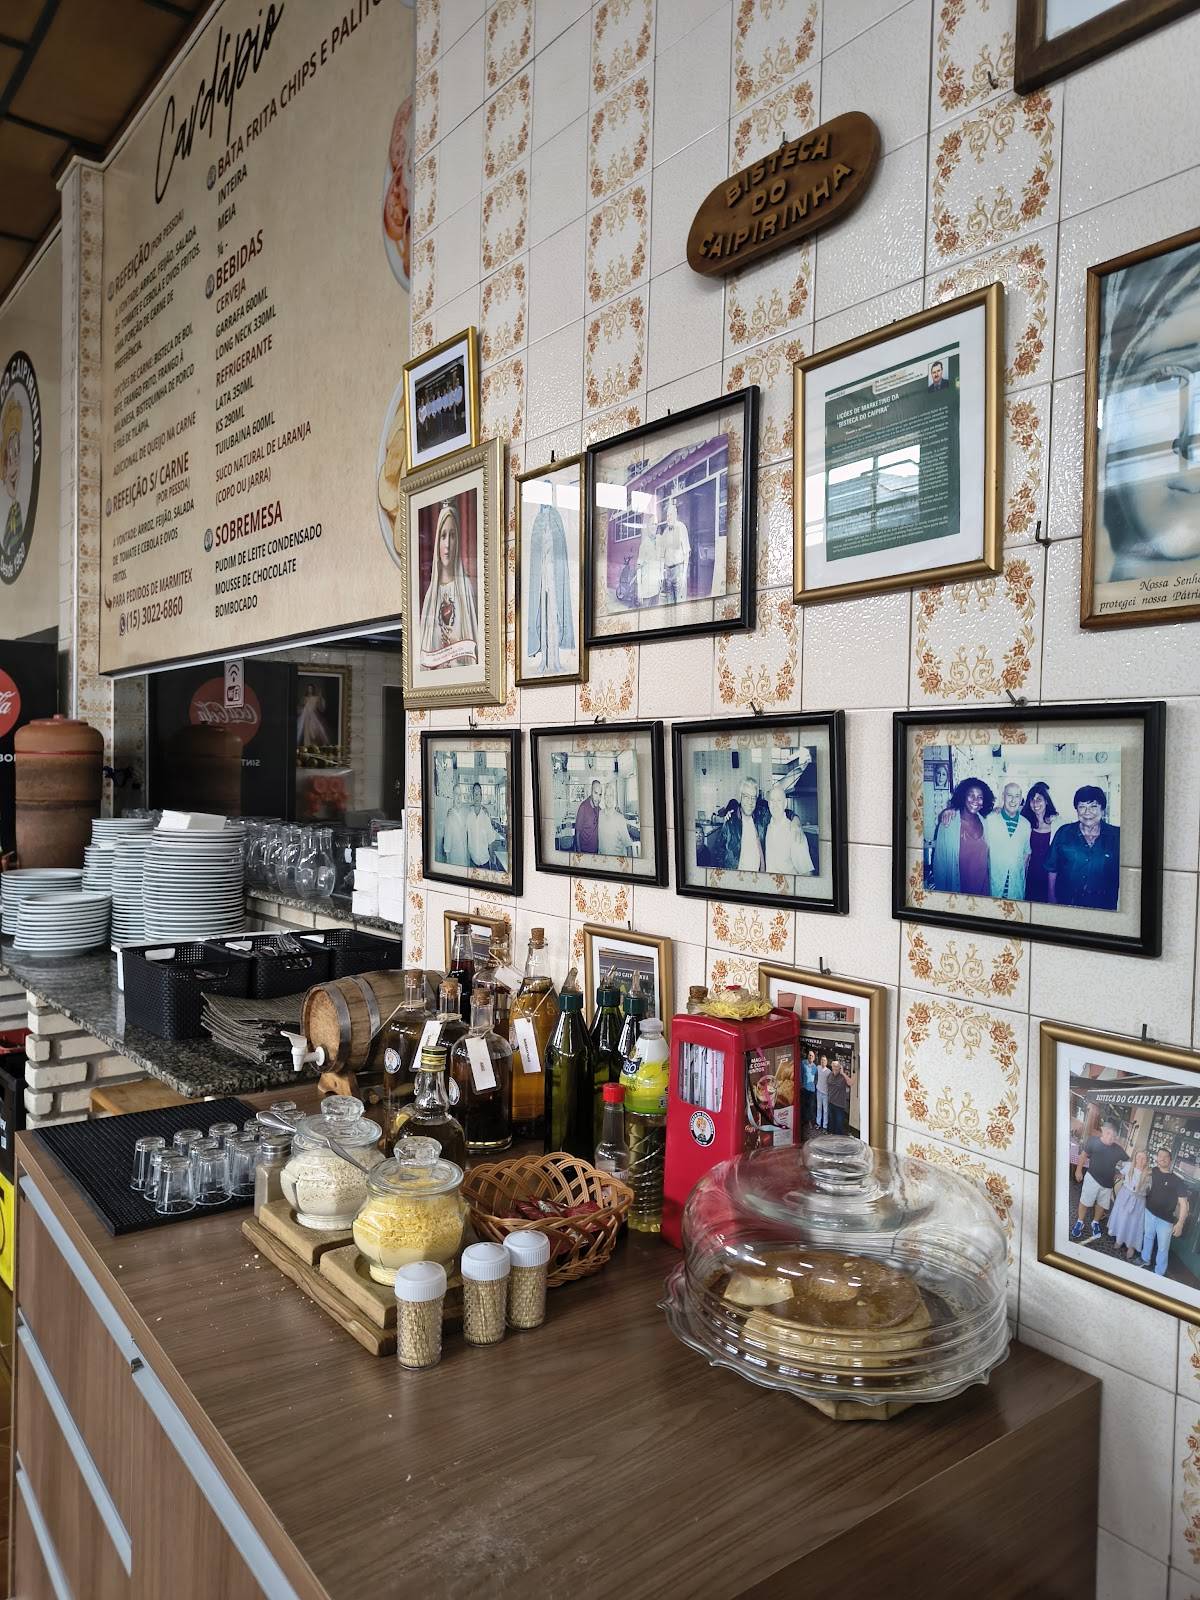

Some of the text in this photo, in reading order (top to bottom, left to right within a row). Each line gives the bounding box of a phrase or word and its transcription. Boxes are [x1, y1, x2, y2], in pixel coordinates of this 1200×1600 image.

[155, 3, 284, 205] Cardápio
[218, 136, 244, 178] BATA
[246, 98, 278, 147] FRITA
[280, 52, 317, 109] CHIPS
[320, 39, 327, 66] E
[218, 164, 247, 206] INTEIRA
[726, 132, 832, 208] BISTECA
[218, 202, 236, 232] MEIA
[700, 162, 852, 259] CAIPIRINHA
[752, 179, 787, 215] DO
[175, 224, 197, 256] SALADA
[216, 229, 263, 290] BEBIDAS
[115, 242, 150, 294] REFEIÇÃO
[143, 282, 161, 308] CEBOLA
[165, 261, 180, 286] OVOS
[143, 312, 149, 327] DE
[150, 296, 166, 320] CARNE
[167, 288, 174, 305] DE
[215, 286, 268, 338] GARRAFA 600ML
[216, 277, 246, 314] CERVEJA
[215, 304, 277, 361] LONG NECK 330ML
[130, 371, 137, 385] DE
[154, 338, 174, 365] BISTECA
[174, 330, 181, 348] DE
[215, 333, 273, 388] REFRIGERANTE
[124, 384, 142, 409] FRANGO
[158, 354, 179, 380] FRANGO
[136, 384, 168, 417] BISTEQUINHA
[168, 377, 175, 394] DE
[175, 362, 195, 388] PORCO
[215, 375, 255, 412] LATA 350ML
[215, 405, 245, 434] KS 290ML
[252, 411, 276, 435] 600ML
[836, 393, 899, 421] LIÇÕES DE MARKETING DA
[859, 412, 867, 421] DO
[113, 410, 196, 478] ADICIONAL DE QUEIJO NA CARNE
[215, 420, 312, 482] SUCO NATURAL DE LARANJA
[113, 451, 189, 513] REFEIÇÃO S/ CARNE
[169, 476, 190, 499] PESSOA)
[215, 466, 272, 506] (COPO OU JARRA)
[173, 498, 194, 519] SALADA
[215, 500, 283, 547] SOBREMESA
[113, 554, 118, 566] DE
[119, 545, 137, 562] TOMATE
[141, 536, 159, 553] CEBOLA
[163, 527, 178, 544] OVOS
[215, 523, 322, 573] PUDIM DE LEITE CONDENSADO
[112, 567, 193, 609] PARA PEDIDOS DE MARMITEX
[215, 558, 297, 596] MOUSSE DE CHOCOLATE
[1140, 578, 1168, 591] Nossa
[127, 595, 183, 632] (15) 3022-6860
[215, 594, 258, 618] BOMBOCADO
[1100, 596, 1136, 612] protegei
[1142, 594, 1167, 604] nossa
[1116, 1095, 1126, 1103] DO
[1127, 1095, 1200, 1108] CAIPIRINHA
